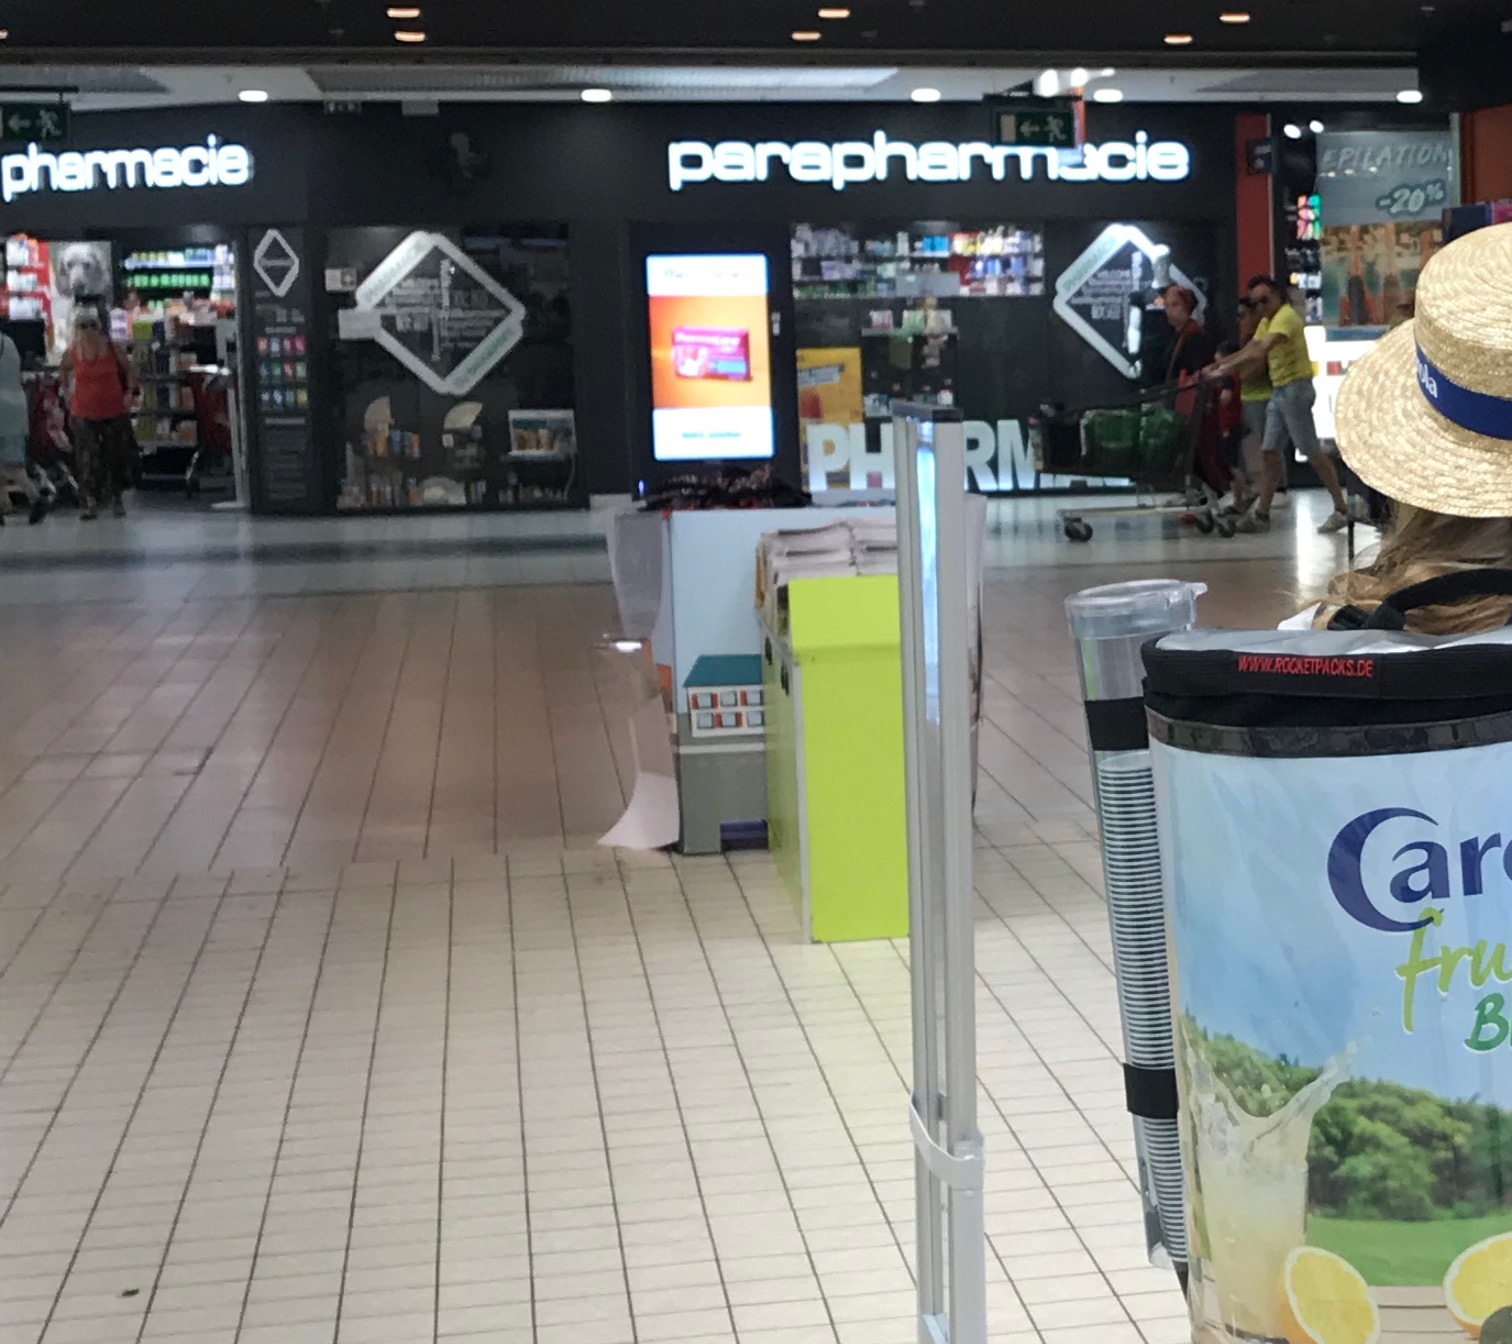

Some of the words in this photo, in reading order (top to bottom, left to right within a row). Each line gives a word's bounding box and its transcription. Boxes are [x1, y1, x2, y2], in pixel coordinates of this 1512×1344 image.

[1, 133, 251, 203] pharmacie
[667, 130, 1190, 192] parapharmacie
[1238, 655, 1374, 678] WWW.ROCKETPACKS.DE
